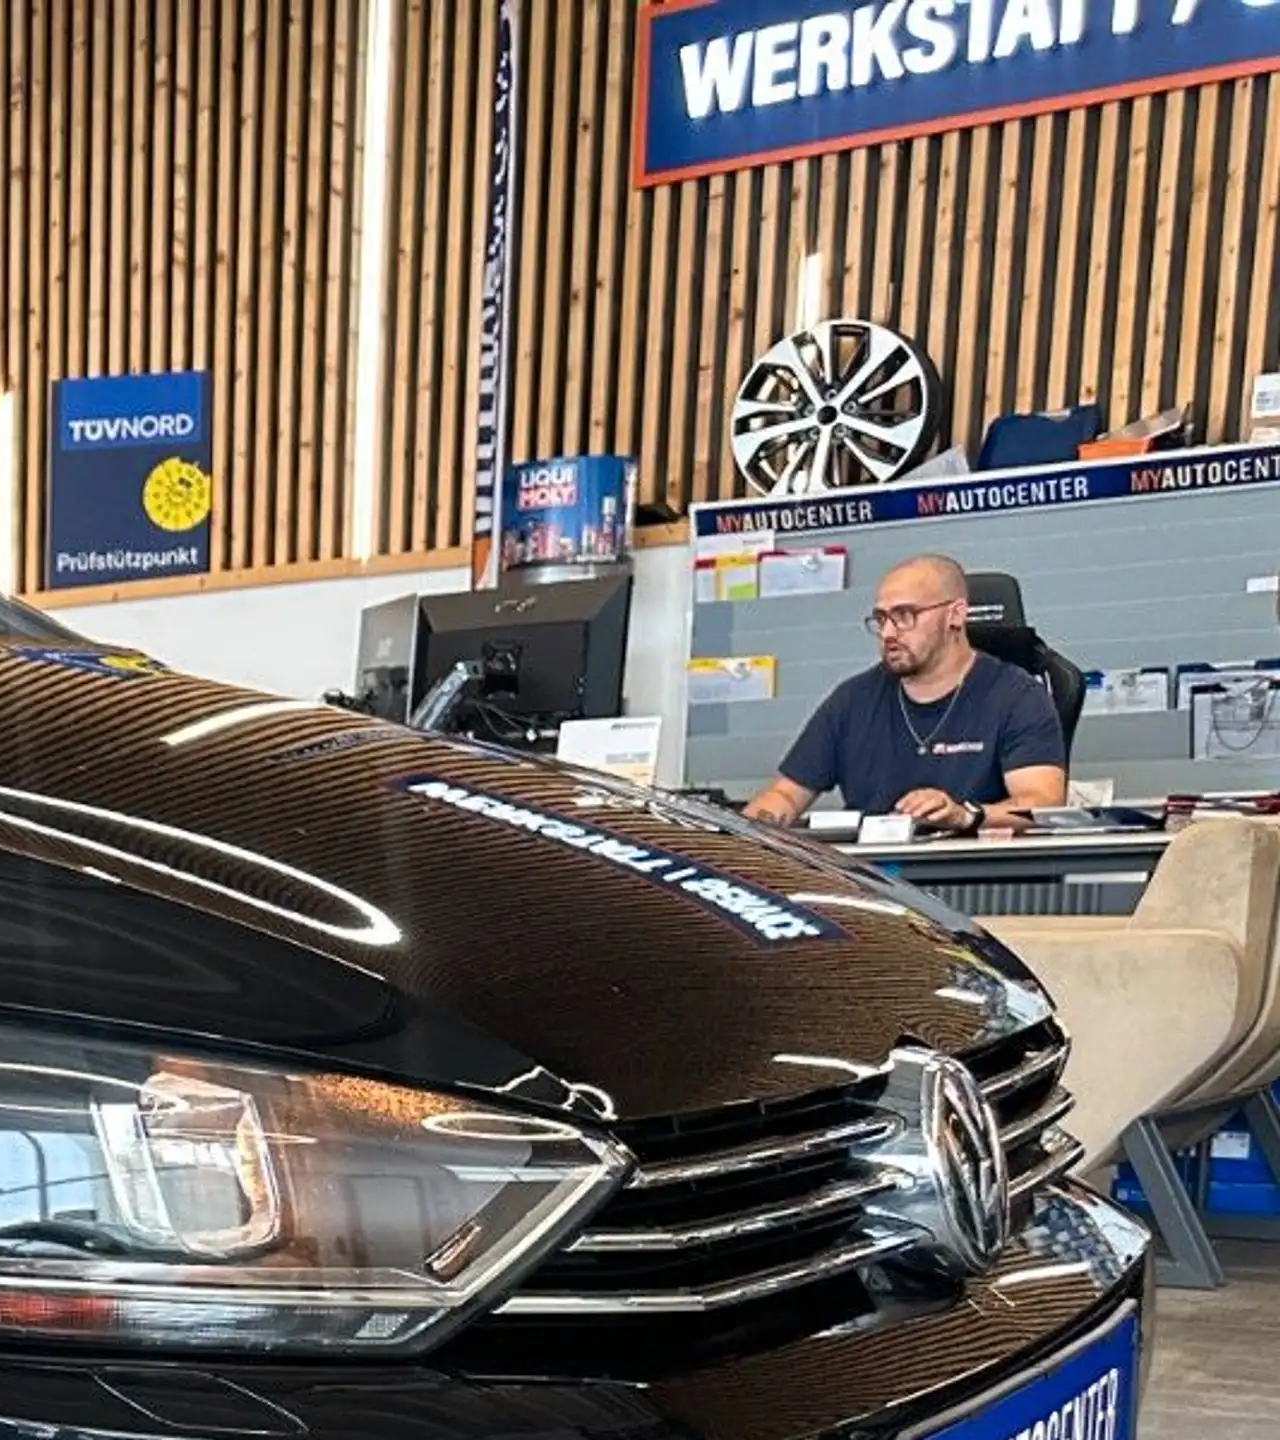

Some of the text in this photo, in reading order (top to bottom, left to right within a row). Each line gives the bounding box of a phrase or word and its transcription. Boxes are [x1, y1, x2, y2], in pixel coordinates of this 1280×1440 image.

[520, 464, 575, 487] LIQUI
[917, 476, 1089, 514] MYAUTOCENTER
[57, 547, 198, 573] Prüfstützpunkt
